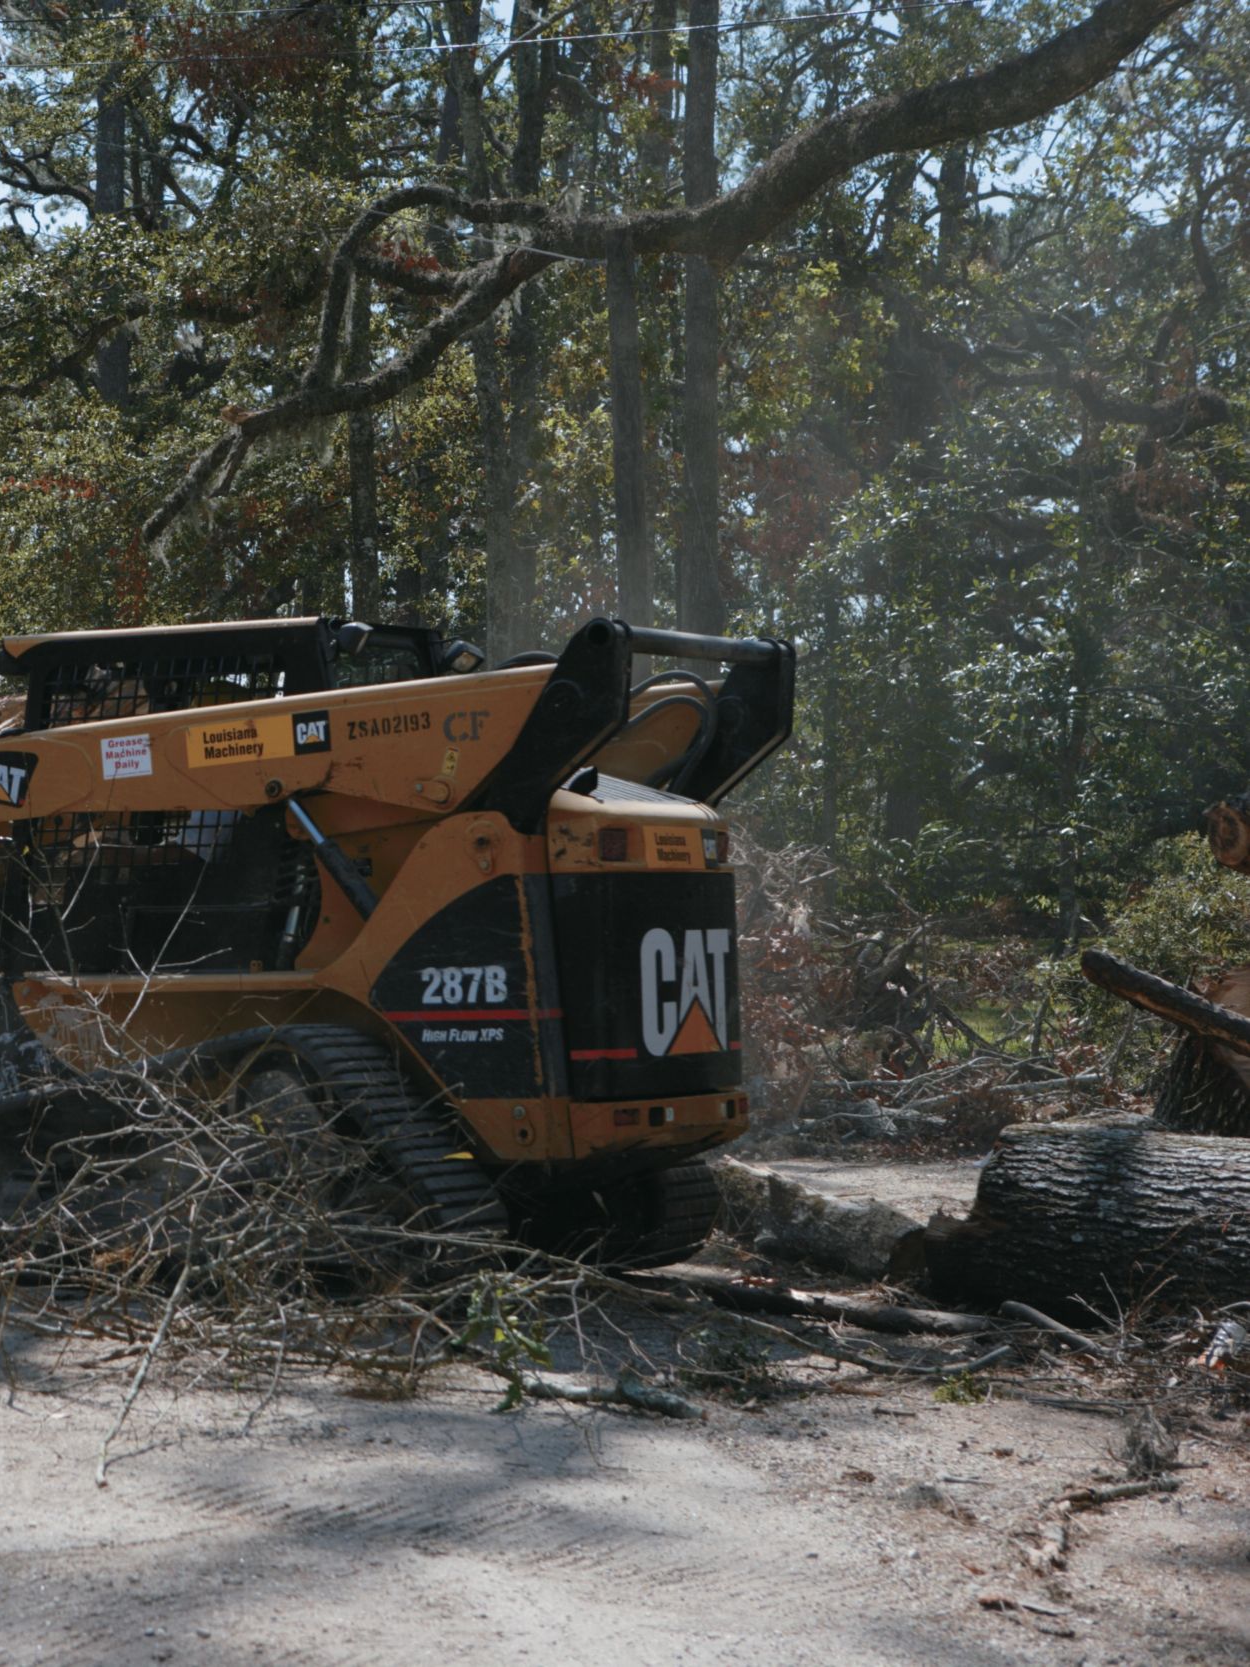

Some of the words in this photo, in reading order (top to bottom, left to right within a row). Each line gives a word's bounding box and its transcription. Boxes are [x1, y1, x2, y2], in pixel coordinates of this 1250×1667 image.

[296, 720, 328, 744] CAT
[443, 711, 490, 742] CF
[107, 737, 143, 749] Grease
[202, 727, 258, 745] Louisiana
[105, 748, 148, 760] Machine
[204, 742, 264, 760] Machinery
[114, 760, 140, 770] Daily
[657, 848, 691, 864] Machinery
[421, 965, 508, 1004] 287B
[640, 927, 730, 1057] CAT
[480, 1027, 505, 1042] XPS
